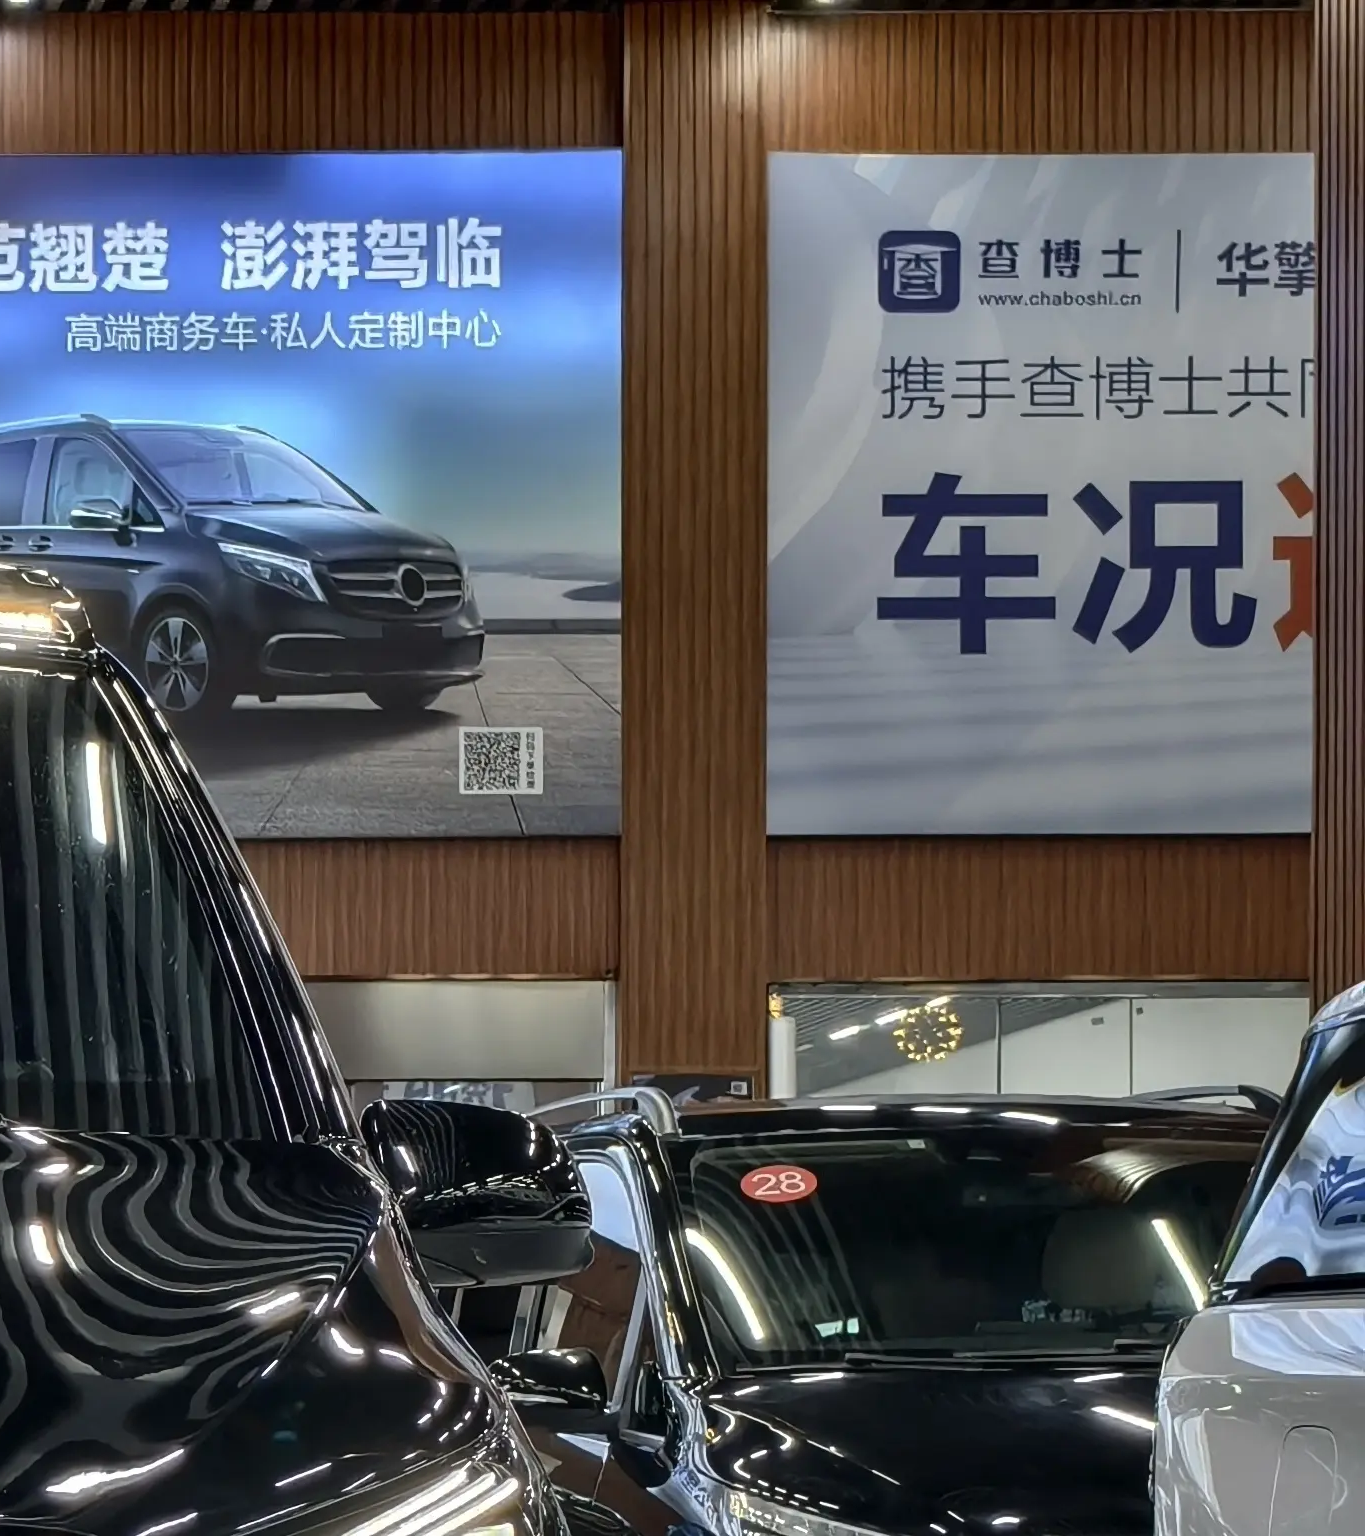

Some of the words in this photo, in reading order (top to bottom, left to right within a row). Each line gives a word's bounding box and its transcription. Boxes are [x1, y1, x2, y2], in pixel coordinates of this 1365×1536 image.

[219, 216, 504, 291] 澎湃驾临
[977, 238, 1144, 279] 查博士
[1215, 240, 1316, 298] 华擎
[977, 290, 1143, 308] www.chaboshi.cn
[880, 355, 1316, 421] 携手查博士共
[876, 471, 1314, 655] 车况
[750, 1170, 807, 1197] 28
